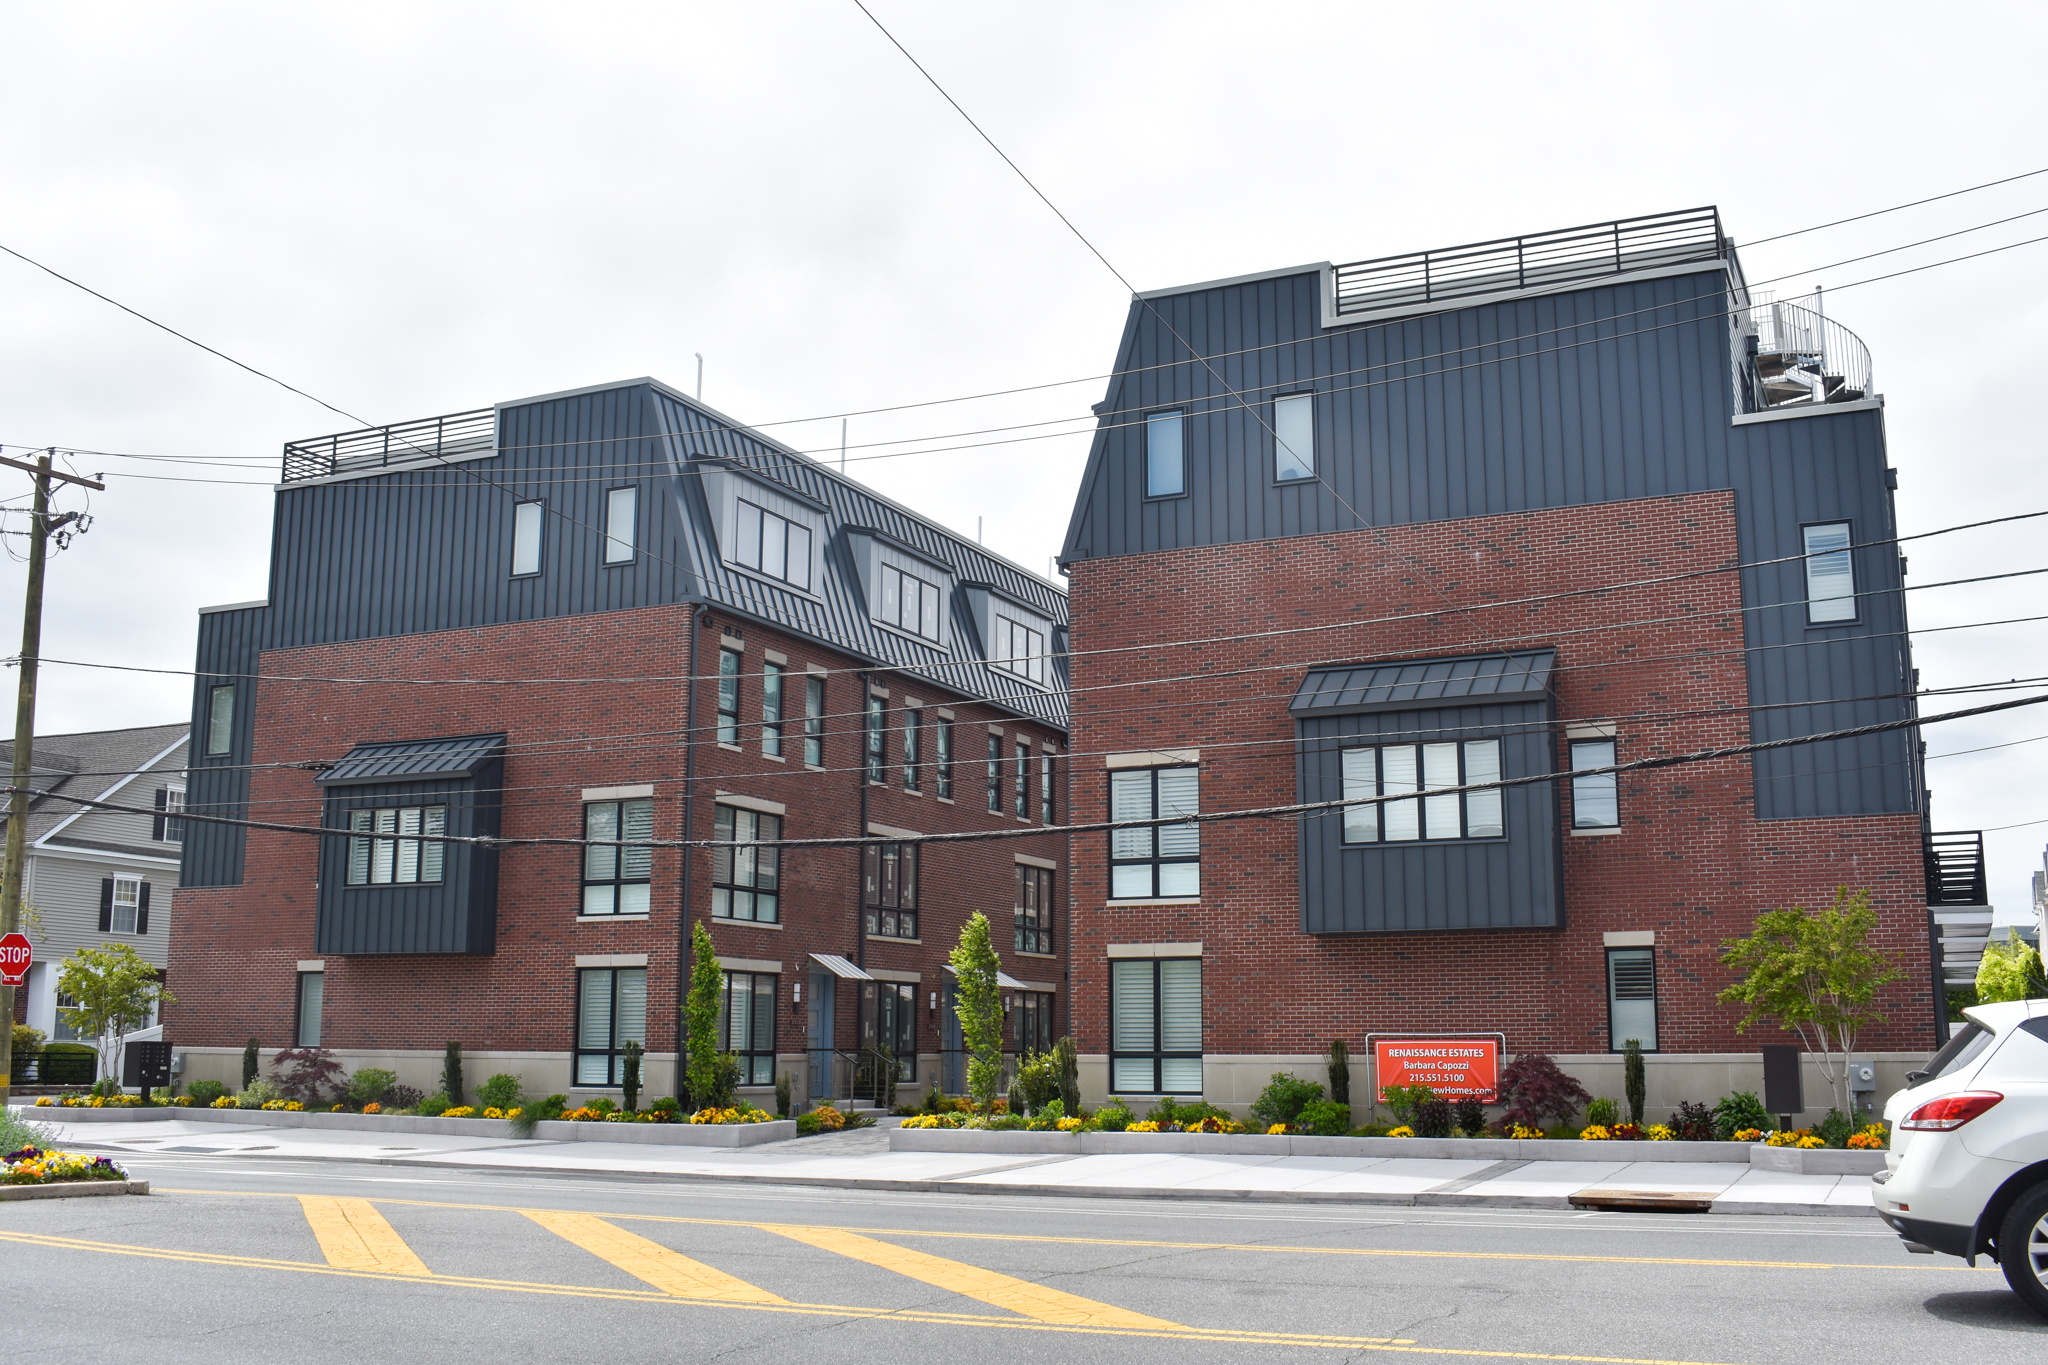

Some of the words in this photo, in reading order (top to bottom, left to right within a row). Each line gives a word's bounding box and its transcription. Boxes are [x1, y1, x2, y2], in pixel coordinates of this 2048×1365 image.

[0, 946, 30, 963] STOP
[1389, 1048, 1447, 1057] RENAISSANCE
[1449, 1048, 1484, 1057] ESTATES
[1404, 1061, 1436, 1070] Barbara
[1437, 1061, 1469, 1071] Capozzi
[1409, 1073, 1465, 1082] 215.551.5100
